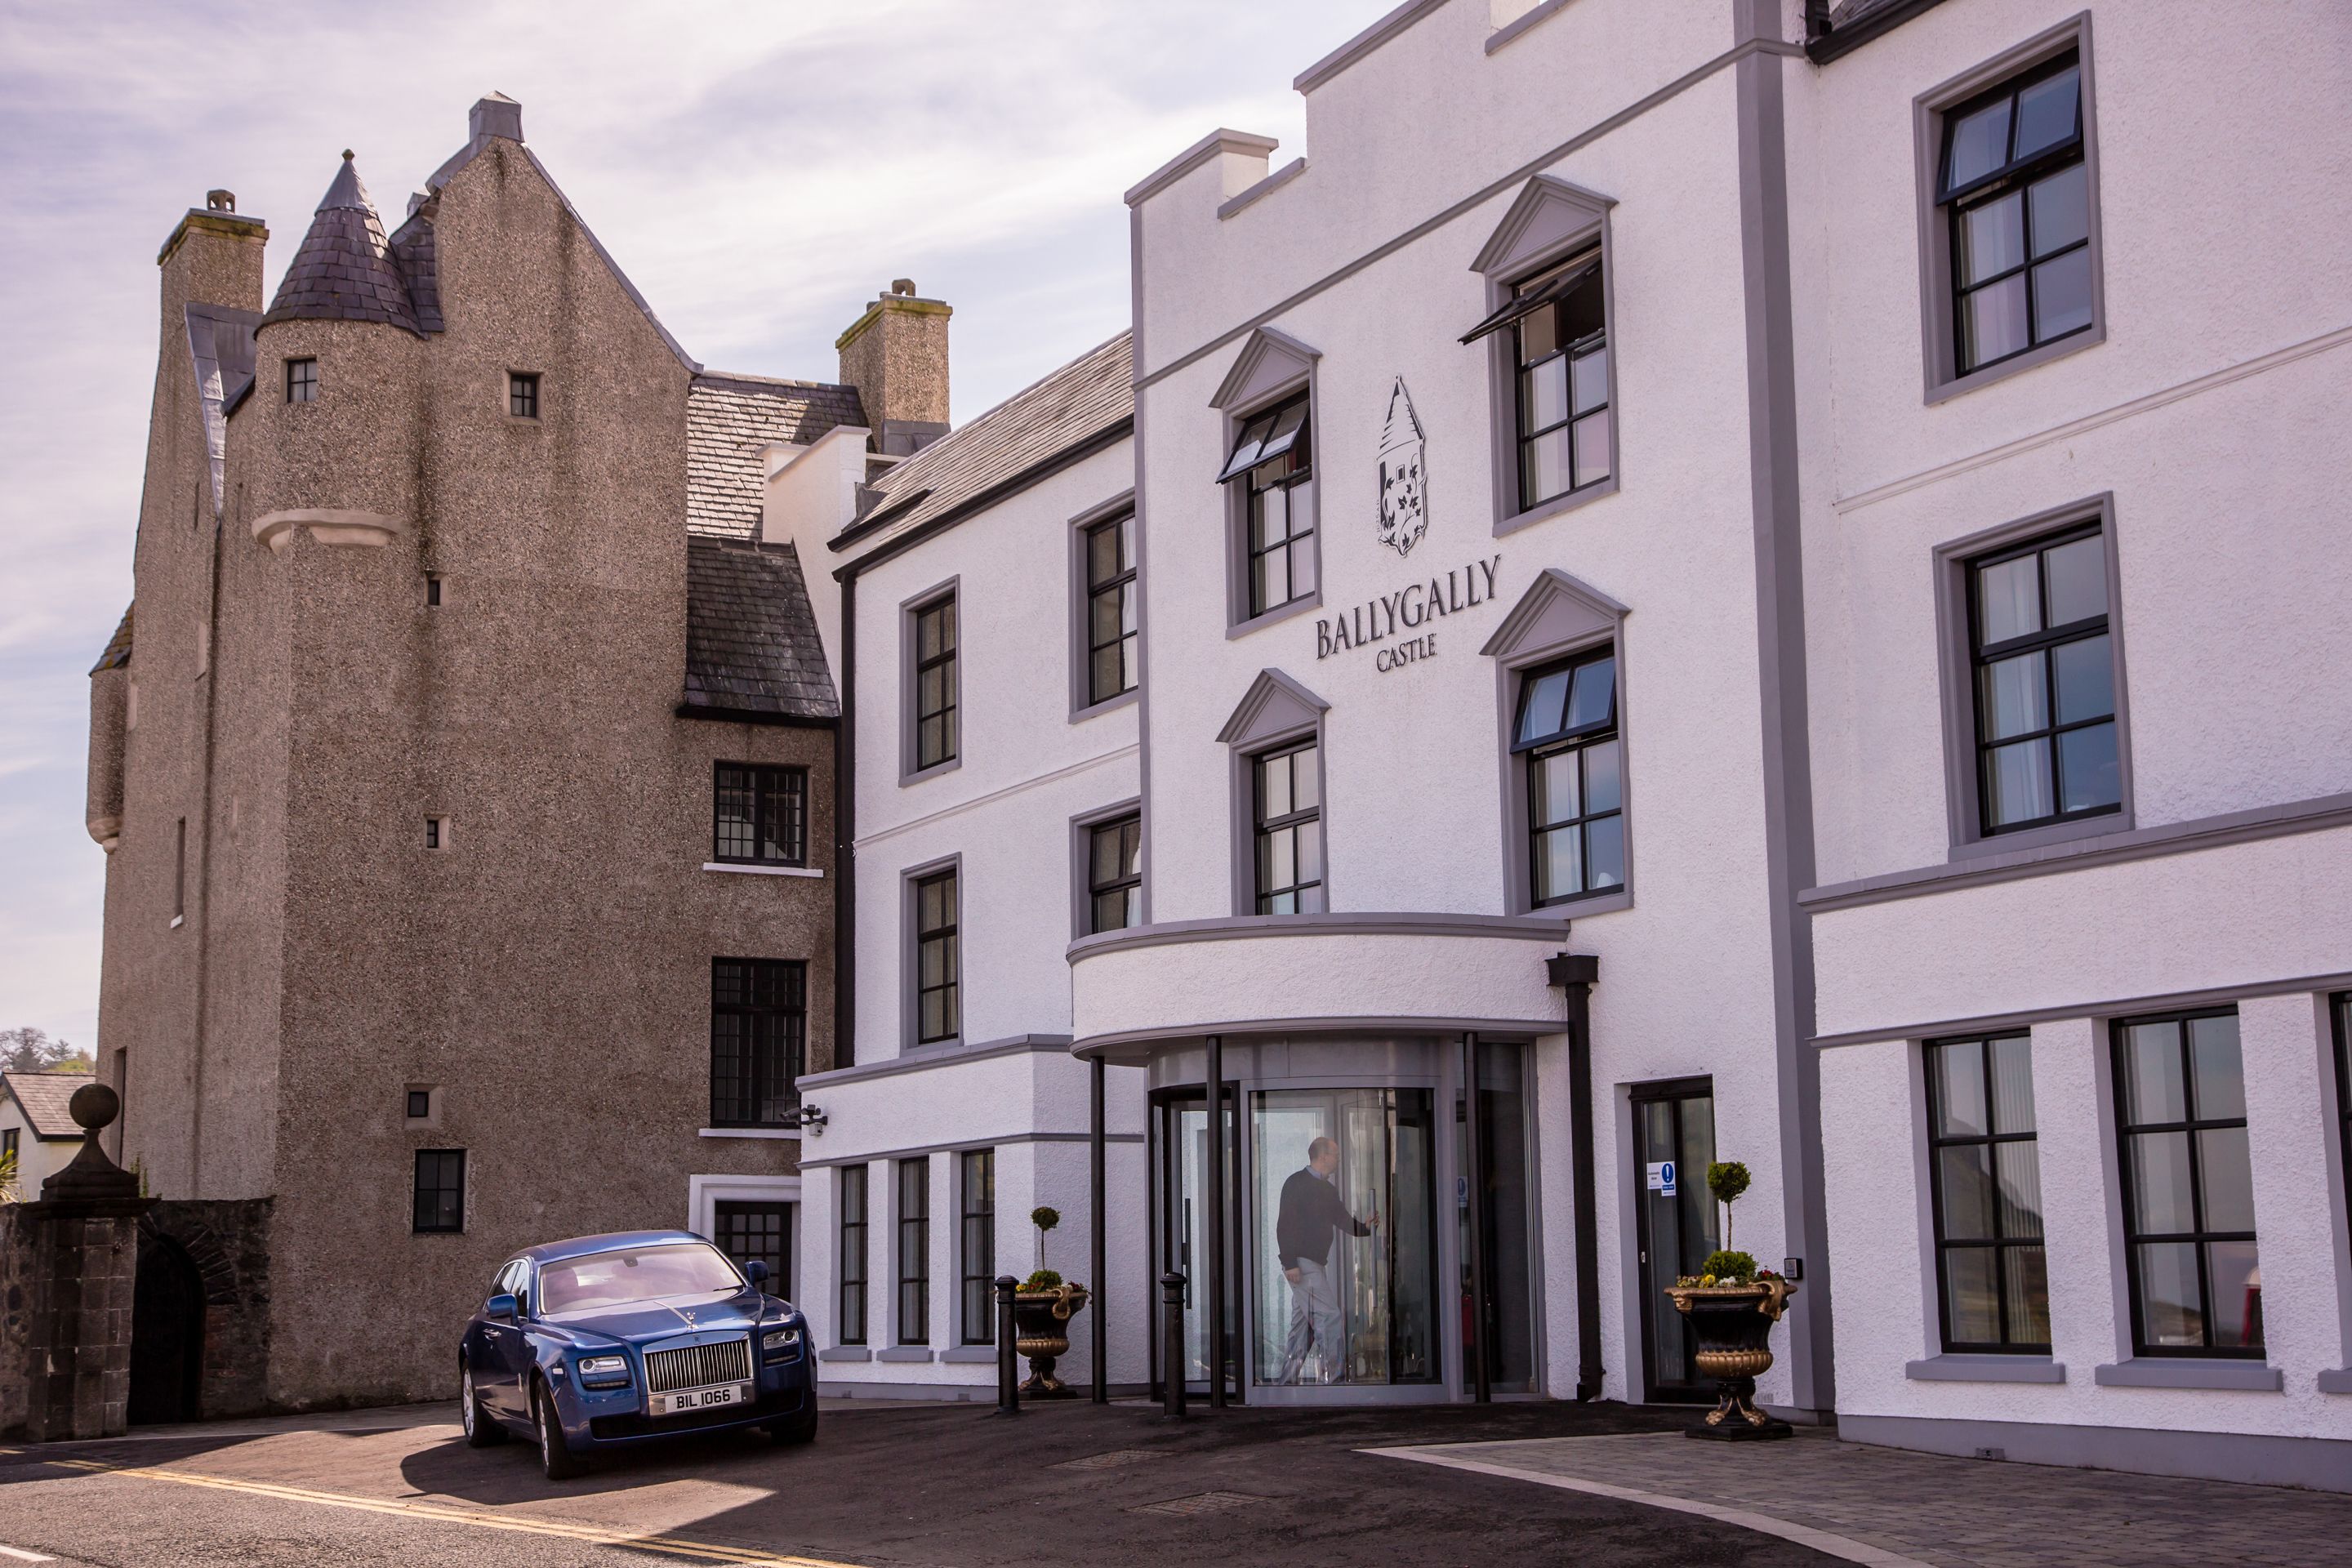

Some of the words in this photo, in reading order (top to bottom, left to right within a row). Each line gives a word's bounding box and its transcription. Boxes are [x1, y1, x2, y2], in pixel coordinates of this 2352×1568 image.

[1316, 554, 1501, 660] BALLYGALLY
[1377, 633, 1437, 672] CASTLE
[676, 1395, 697, 1409] BIL
[701, 1389, 731, 1405] 1066
